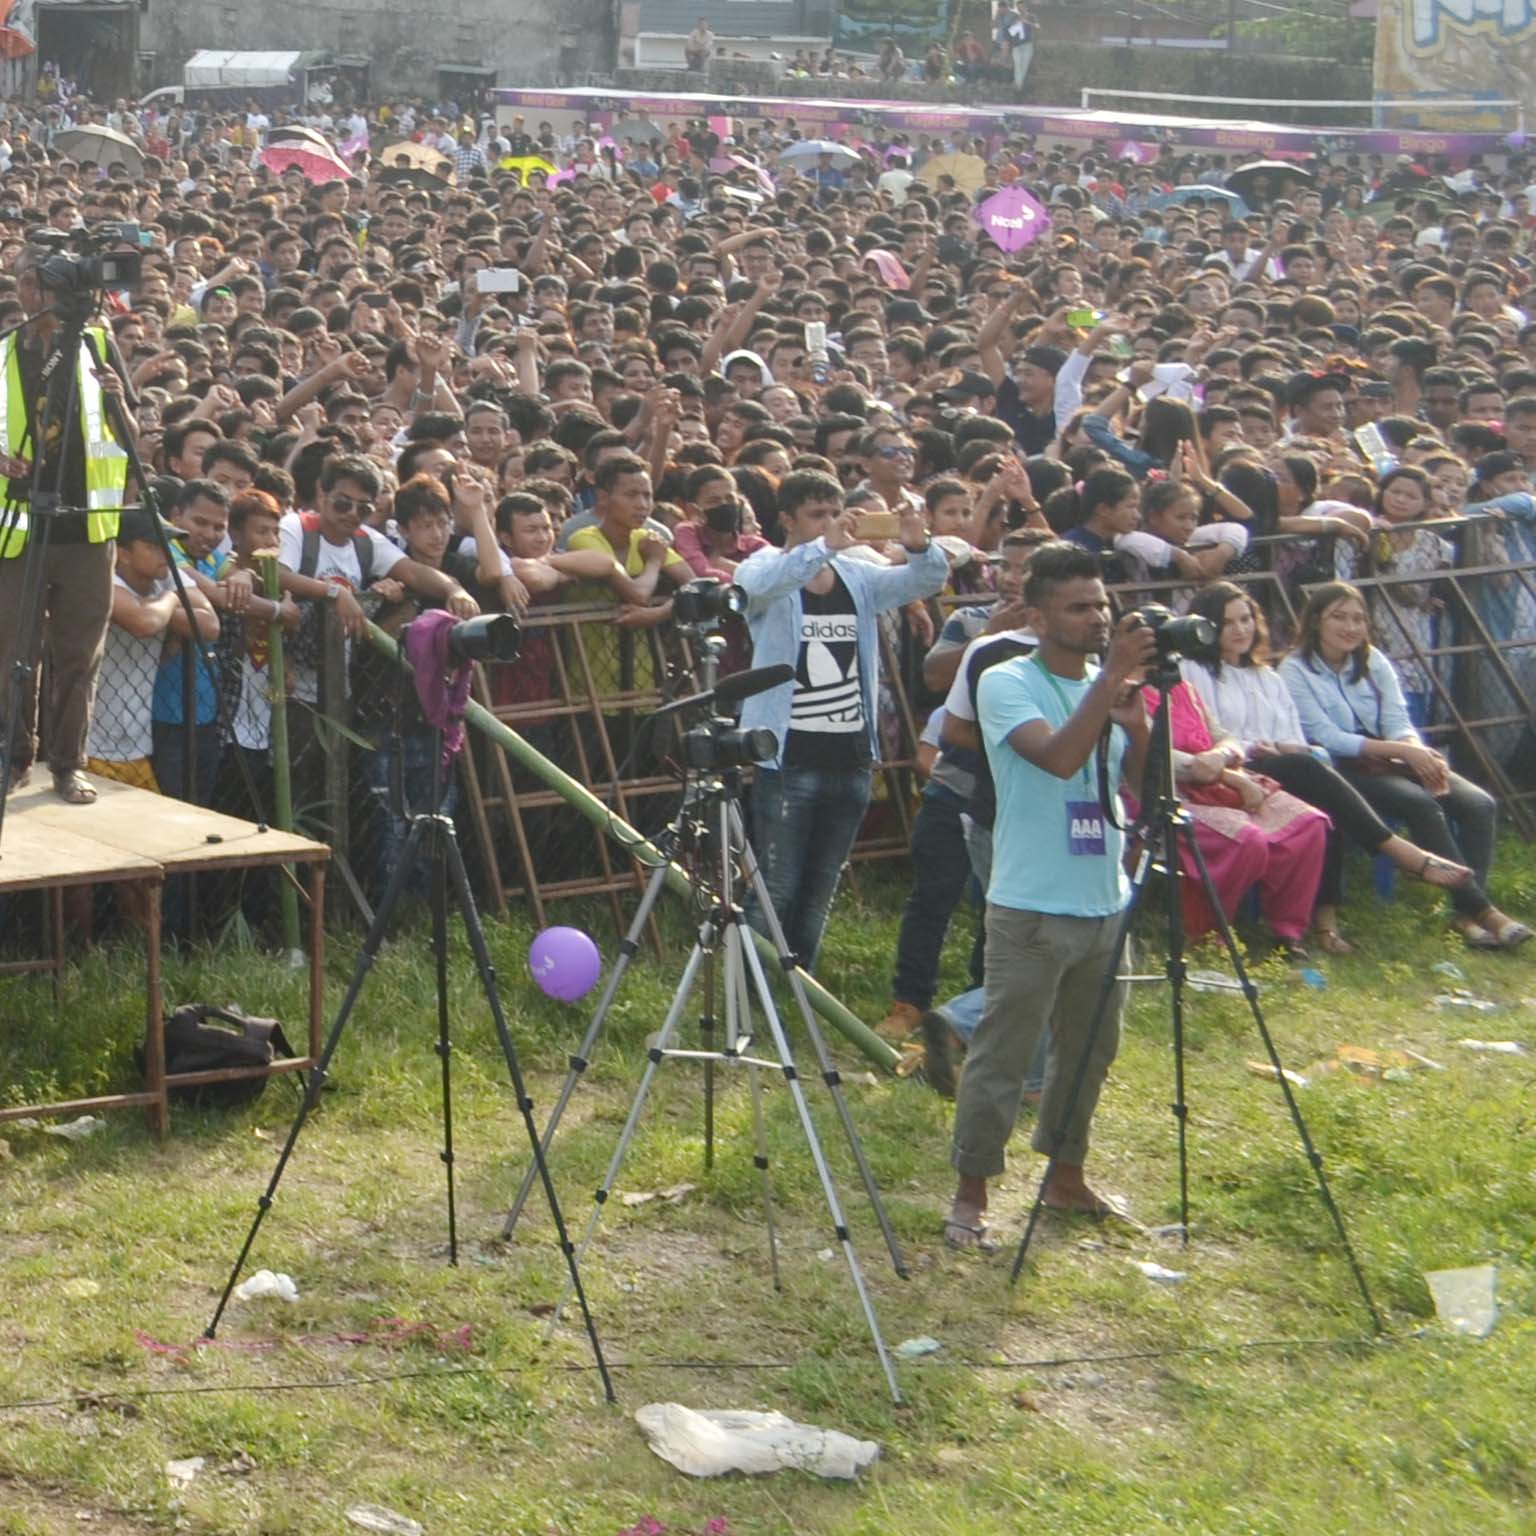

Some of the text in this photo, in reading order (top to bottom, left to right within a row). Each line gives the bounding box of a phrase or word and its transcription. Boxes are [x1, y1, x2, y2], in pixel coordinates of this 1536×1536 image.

[1399, 136, 1447, 153] Bingo
[991, 214, 1023, 229] Ncell
[801, 621, 857, 638] didas
[1071, 818, 1102, 834] AAA
